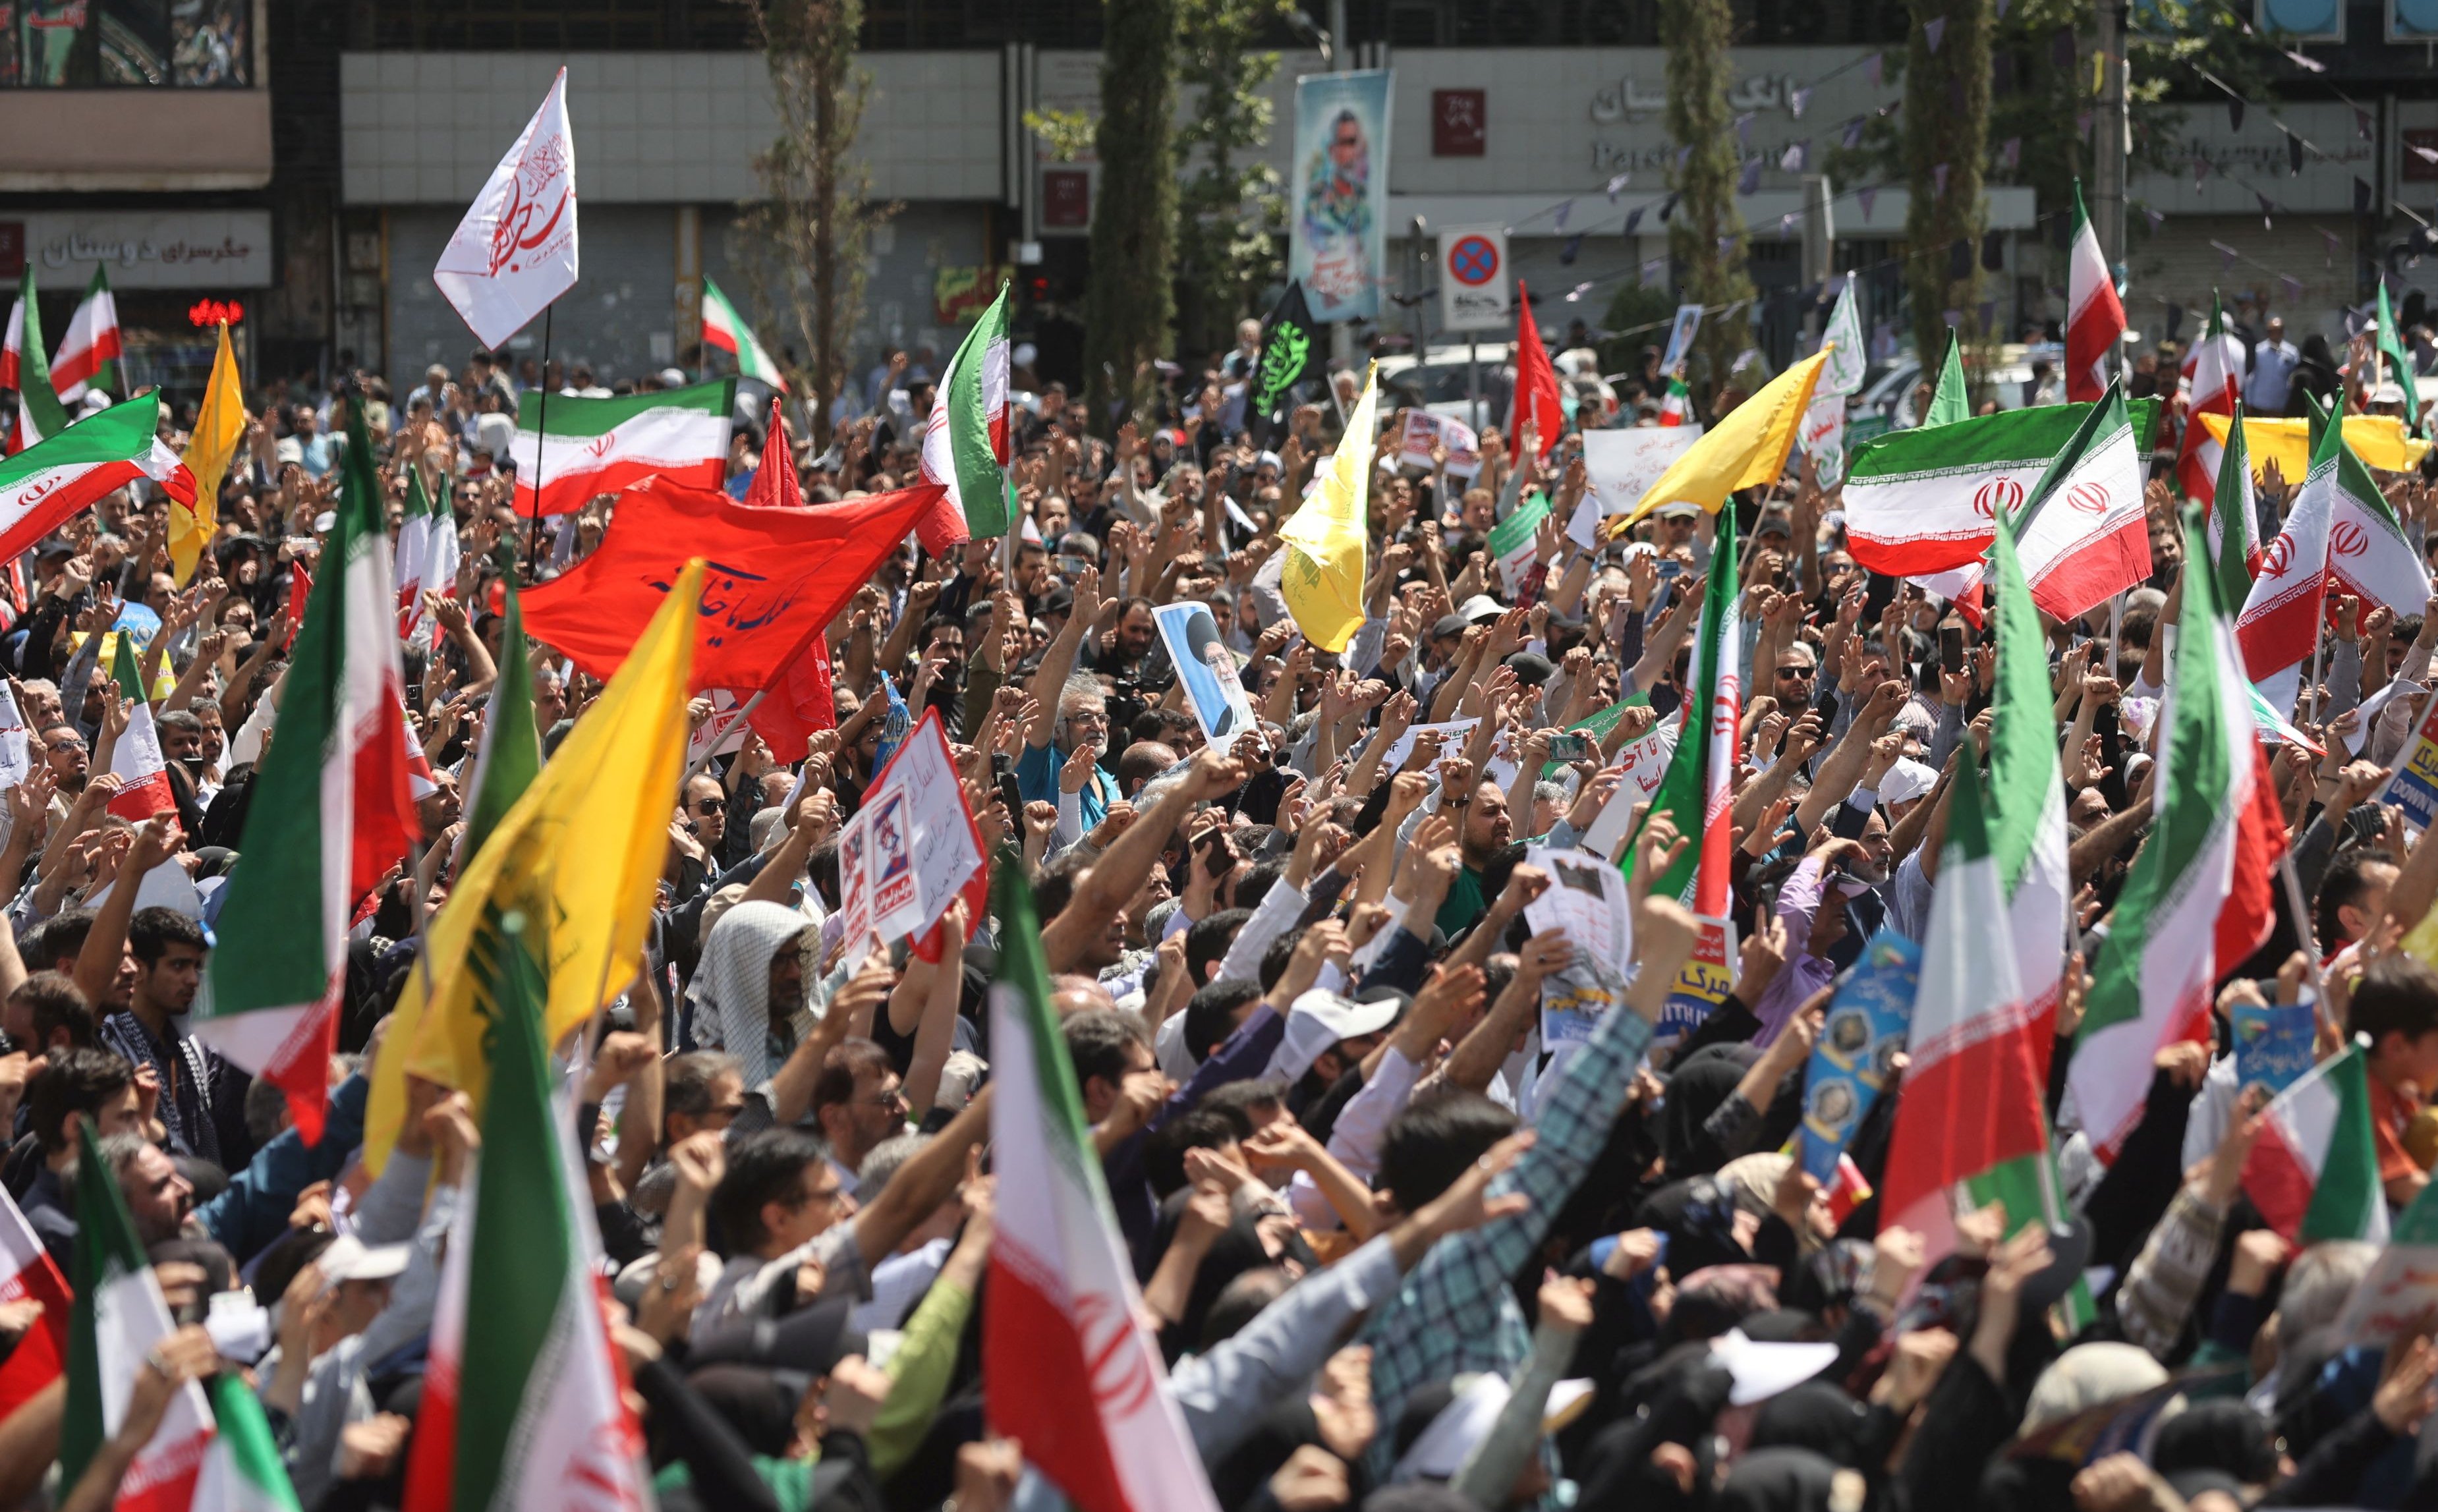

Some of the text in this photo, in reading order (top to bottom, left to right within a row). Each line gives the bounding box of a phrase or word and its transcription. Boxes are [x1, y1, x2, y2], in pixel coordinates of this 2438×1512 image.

[43, 233, 160, 270] دوستان
[1622, 736, 1658, 773] تا آخ
[2391, 777, 2426, 812] DOWN
[1681, 966, 1730, 997] مرگ
